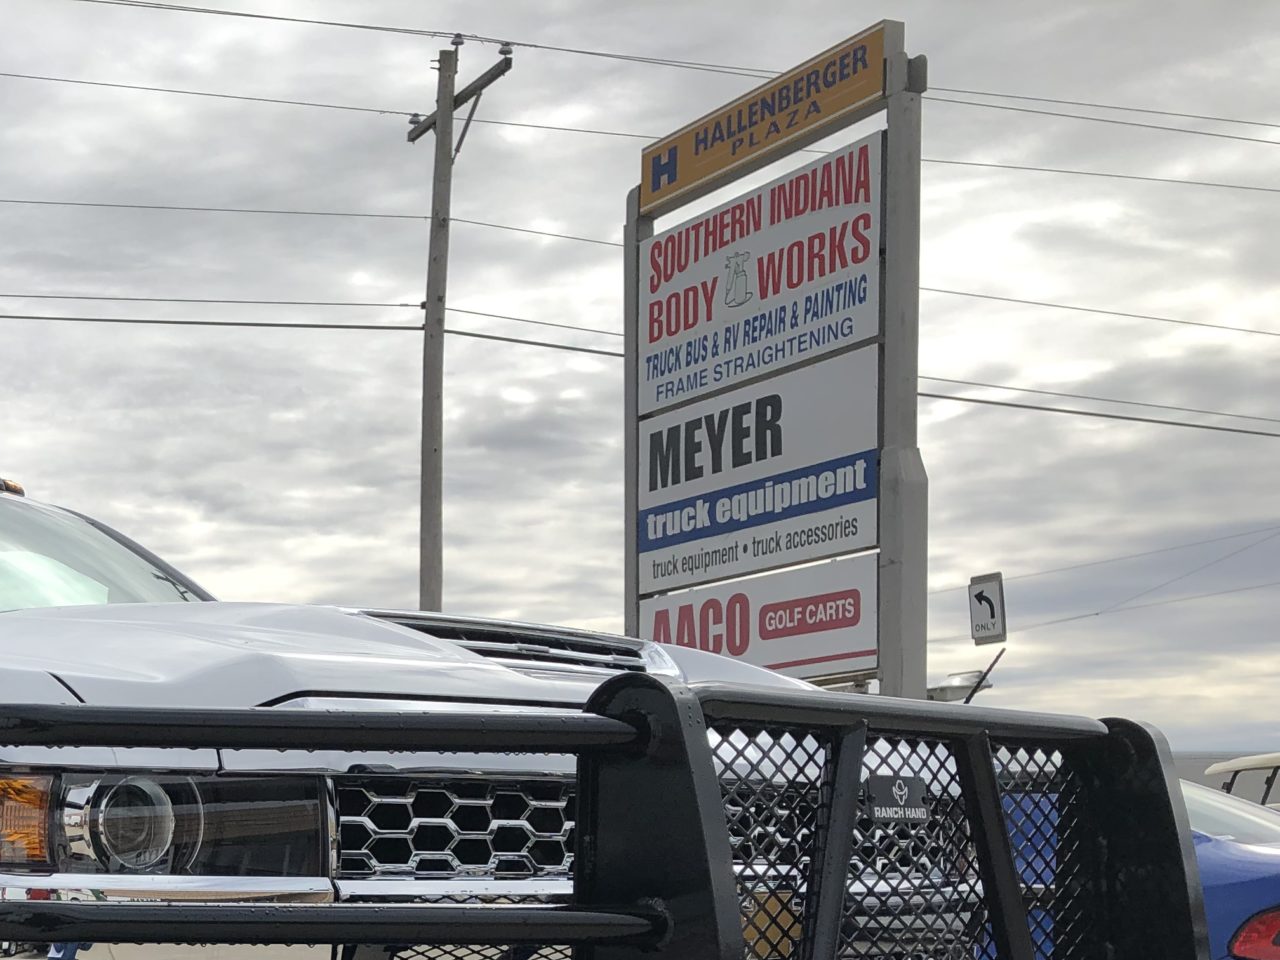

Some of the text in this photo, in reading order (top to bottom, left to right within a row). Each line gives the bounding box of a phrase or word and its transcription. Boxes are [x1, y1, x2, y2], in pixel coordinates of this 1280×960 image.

[694, 45, 868, 156] HALLENBERGER
[731, 100, 822, 156] PLAZA
[651, 145, 678, 193] H
[650, 143, 871, 295] SOUTHERN INDIANA
[649, 213, 872, 344] BODY WORKS
[646, 273, 868, 381] TRUCK BUS & RV REPAIR & PAINTING
[656, 316, 854, 402] FRAME STRAIGHTENING
[648, 393, 783, 492] MEYER
[647, 458, 867, 541] truck equipment
[652, 515, 858, 580] truck equipment truck accessories
[652, 592, 751, 657] AACO
[765, 597, 855, 632] GOLF CARTS
[974, 621, 997, 633] ONLY
[874, 806, 927, 819] RANCH HAND
